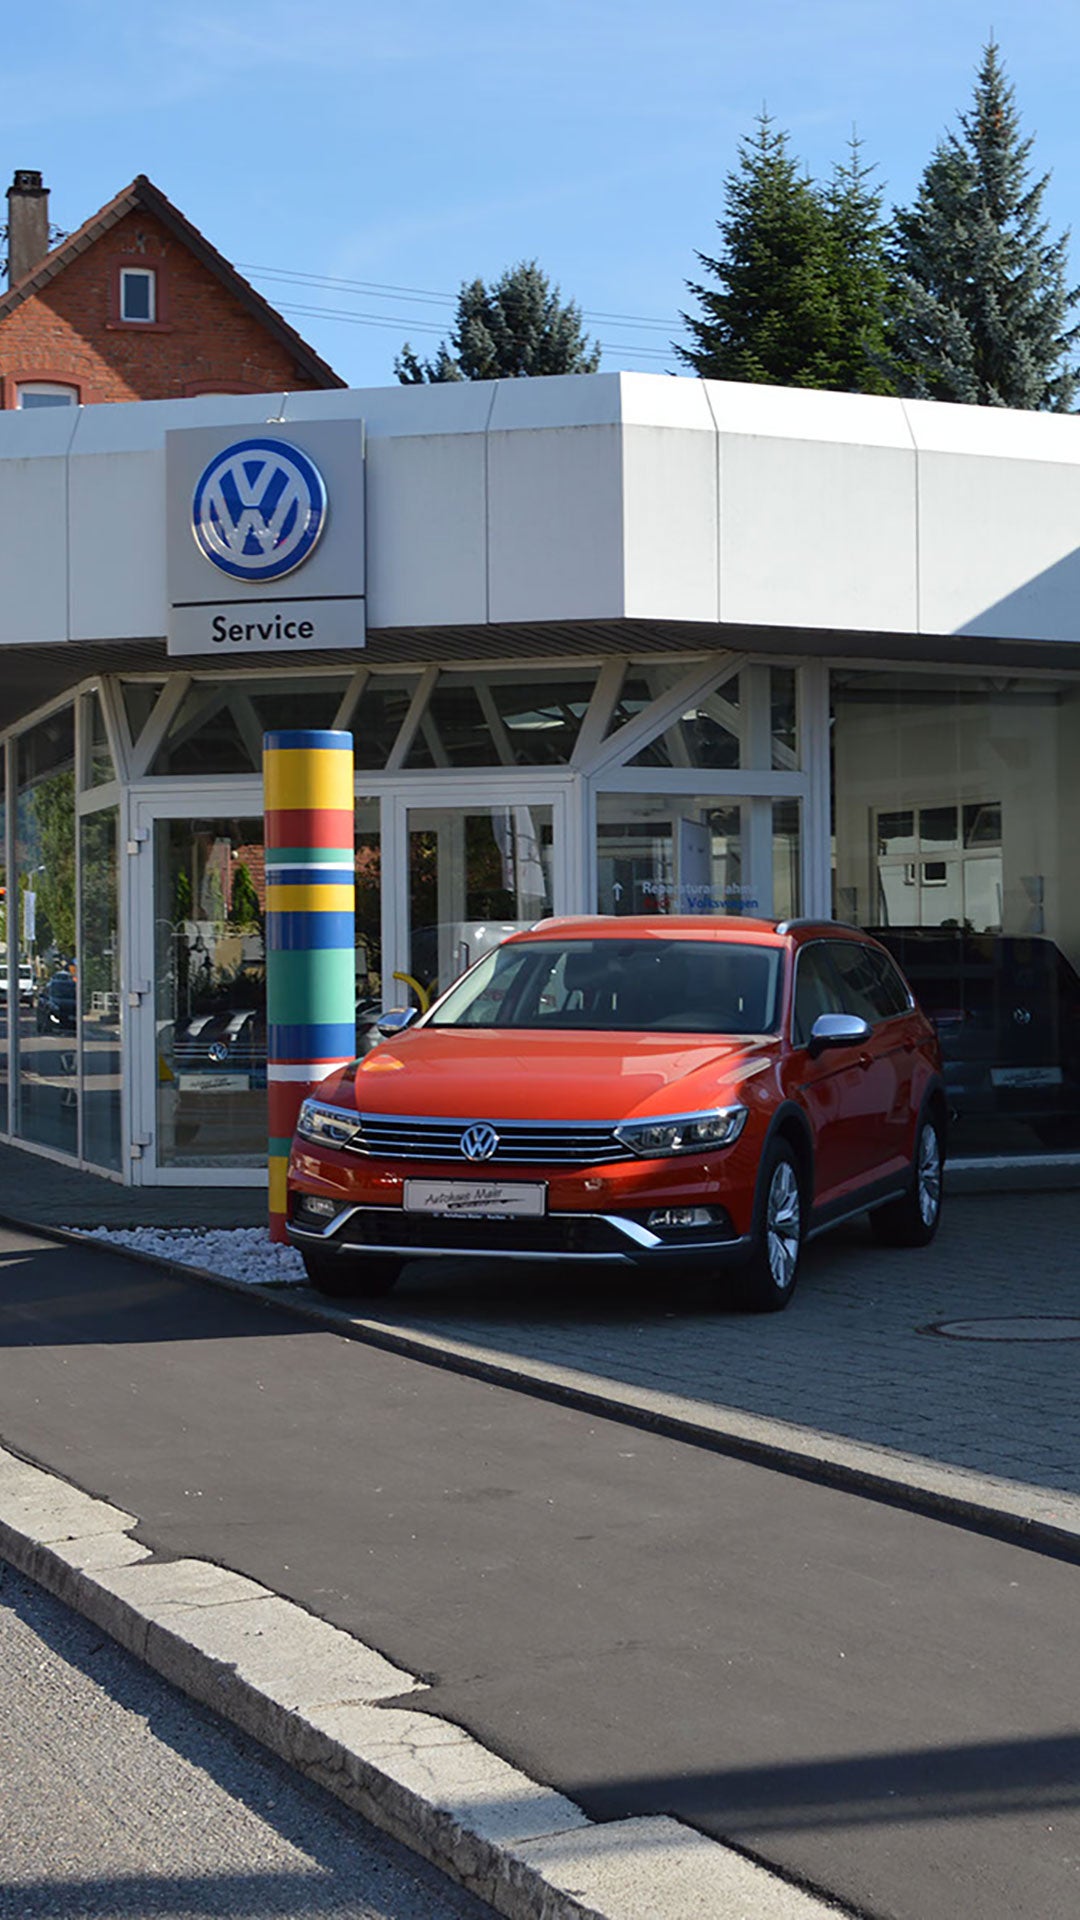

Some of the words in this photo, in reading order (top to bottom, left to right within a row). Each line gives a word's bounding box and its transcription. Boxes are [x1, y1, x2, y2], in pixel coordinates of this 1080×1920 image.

[196, 442, 321, 577] VW
[212, 614, 314, 643] Service
[687, 895, 759, 912] Volkswagen
[461, 1124, 498, 1161] VW
